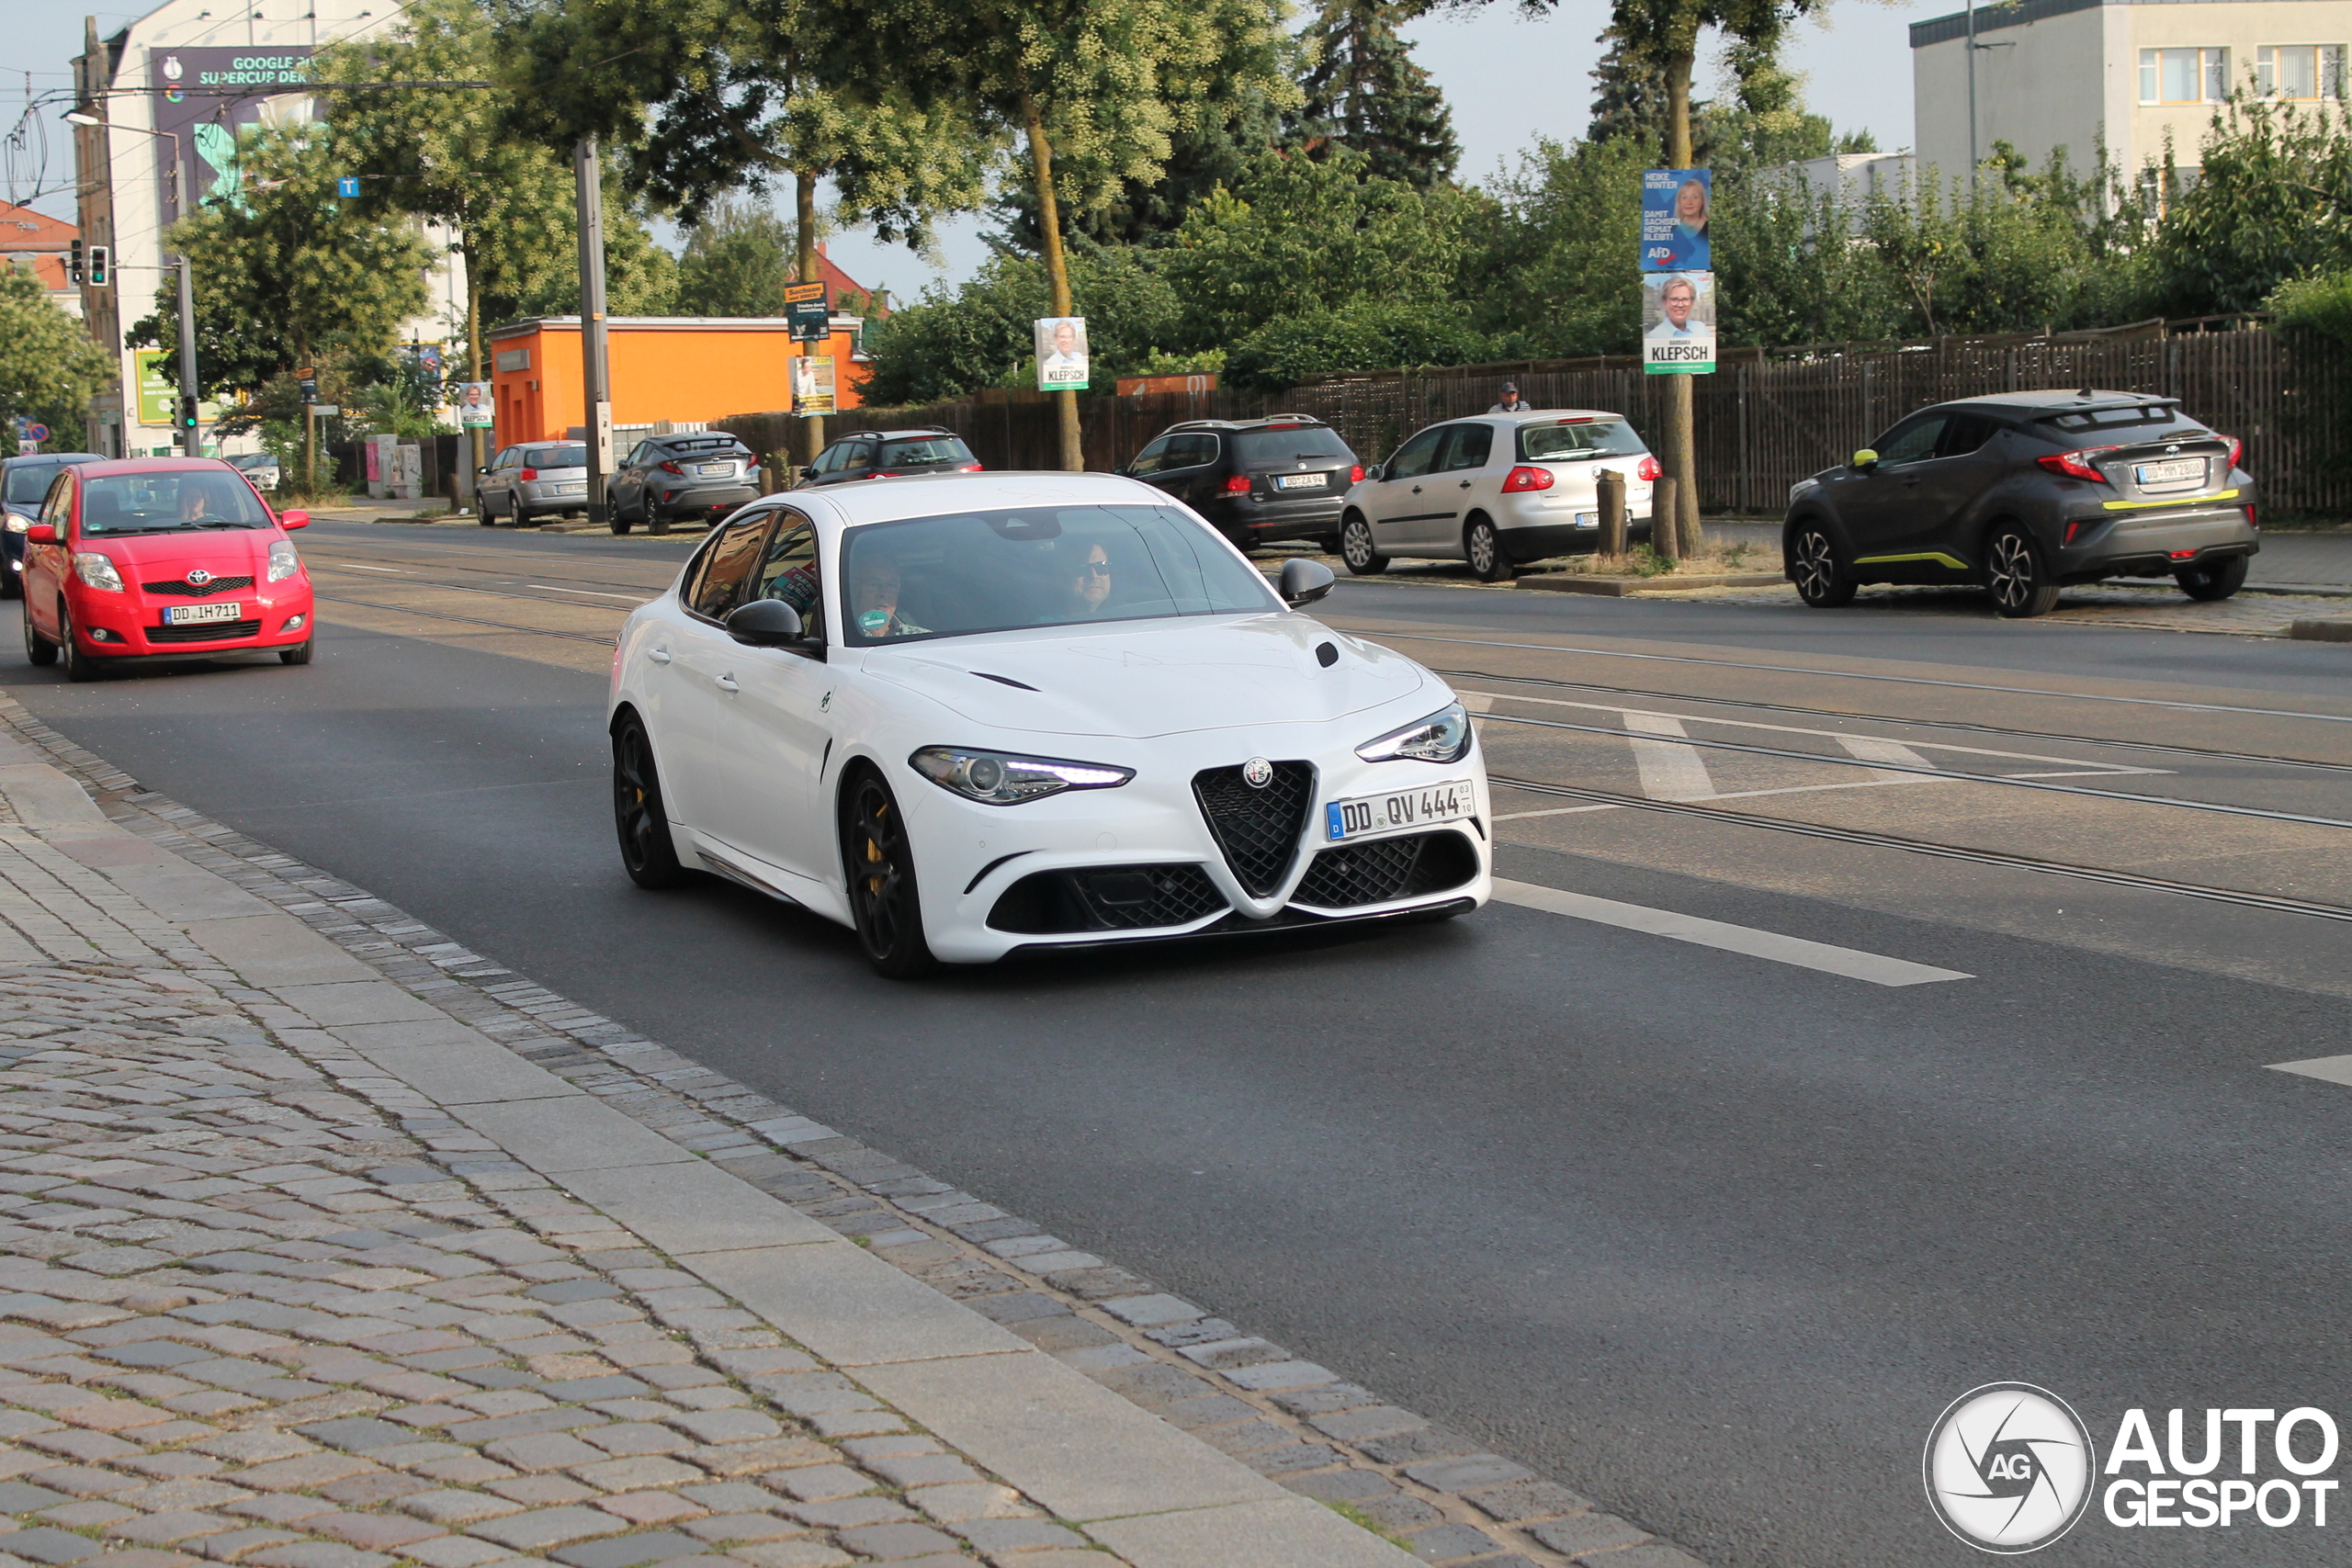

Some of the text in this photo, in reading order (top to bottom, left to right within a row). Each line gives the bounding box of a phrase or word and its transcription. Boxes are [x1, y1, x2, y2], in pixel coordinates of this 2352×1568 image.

[232, 56, 294, 71] GOOGLE
[199, 71, 276, 85] SUPERCUP
[1645, 173, 1670, 181] HEIKE
[342, 179, 355, 194] T
[1645, 181, 1678, 189] WINTER
[1644, 218, 1680, 226] SACHSEN
[1644, 225, 1672, 233] HEIMAT
[1644, 232, 1674, 241] BLEIBT!
[1647, 246, 1671, 258] AfD
[788, 287, 821, 296] Sachsen
[1652, 345, 1708, 361] KLEPSCH
[1048, 369, 1084, 381] KLEPSCH
[2144, 467, 2159, 479] DD
[1286, 477, 1297, 486] DD
[173, 607, 190, 620] DD
[1459, 784, 1469, 794] 03
[1332, 787, 1459, 833] D DD QV 444
[1463, 804, 1472, 813] 10
